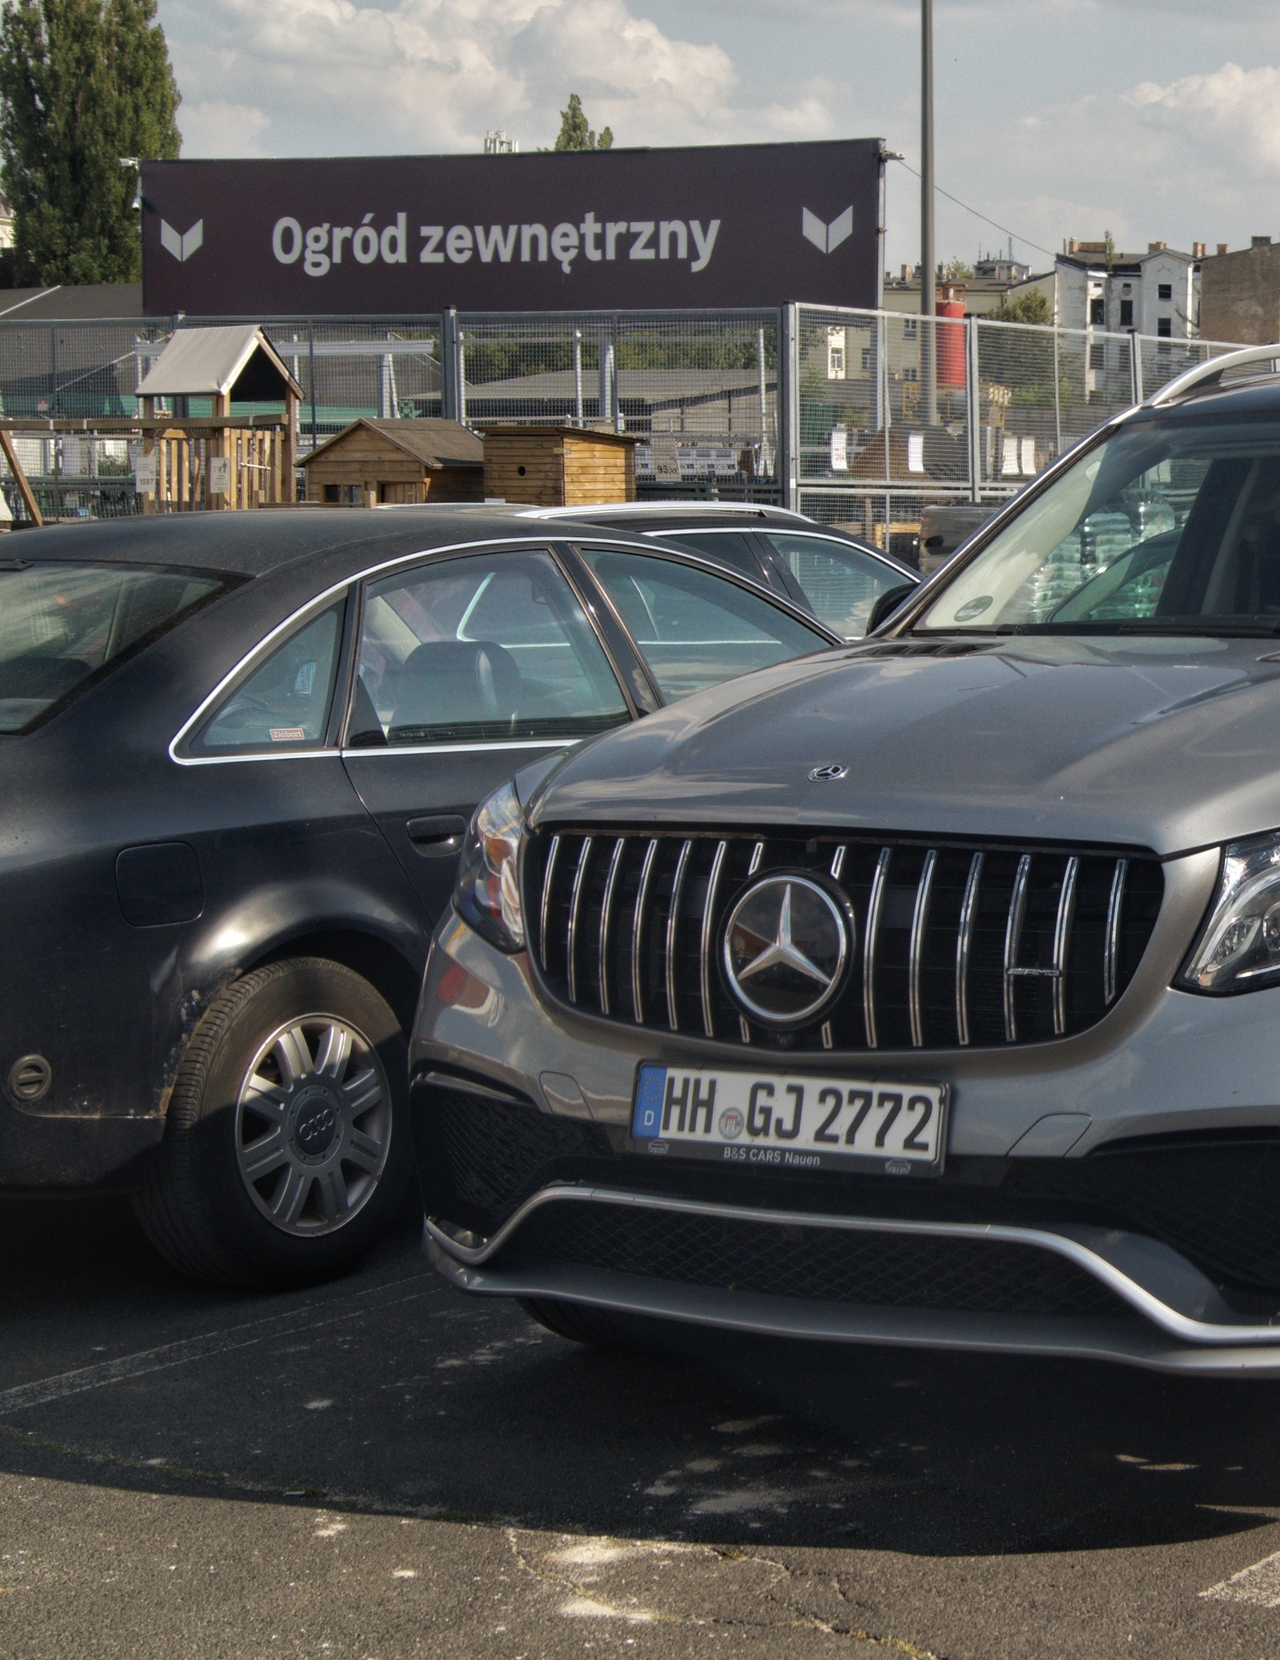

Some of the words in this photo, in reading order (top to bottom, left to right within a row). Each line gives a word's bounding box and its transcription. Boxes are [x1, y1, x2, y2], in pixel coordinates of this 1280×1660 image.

[272, 213, 407, 277] Ogród
[420, 212, 721, 274] zewnętrzny
[272, 730, 302, 739] Ziebart
[643, 1109, 654, 1126] D
[661, 1076, 717, 1134] HH
[746, 1081, 806, 1139] GJ
[813, 1086, 934, 1152] 2772
[723, 1146, 747, 1161] B&S
[749, 1148, 782, 1163] CARS
[784, 1151, 821, 1167] Nauen
